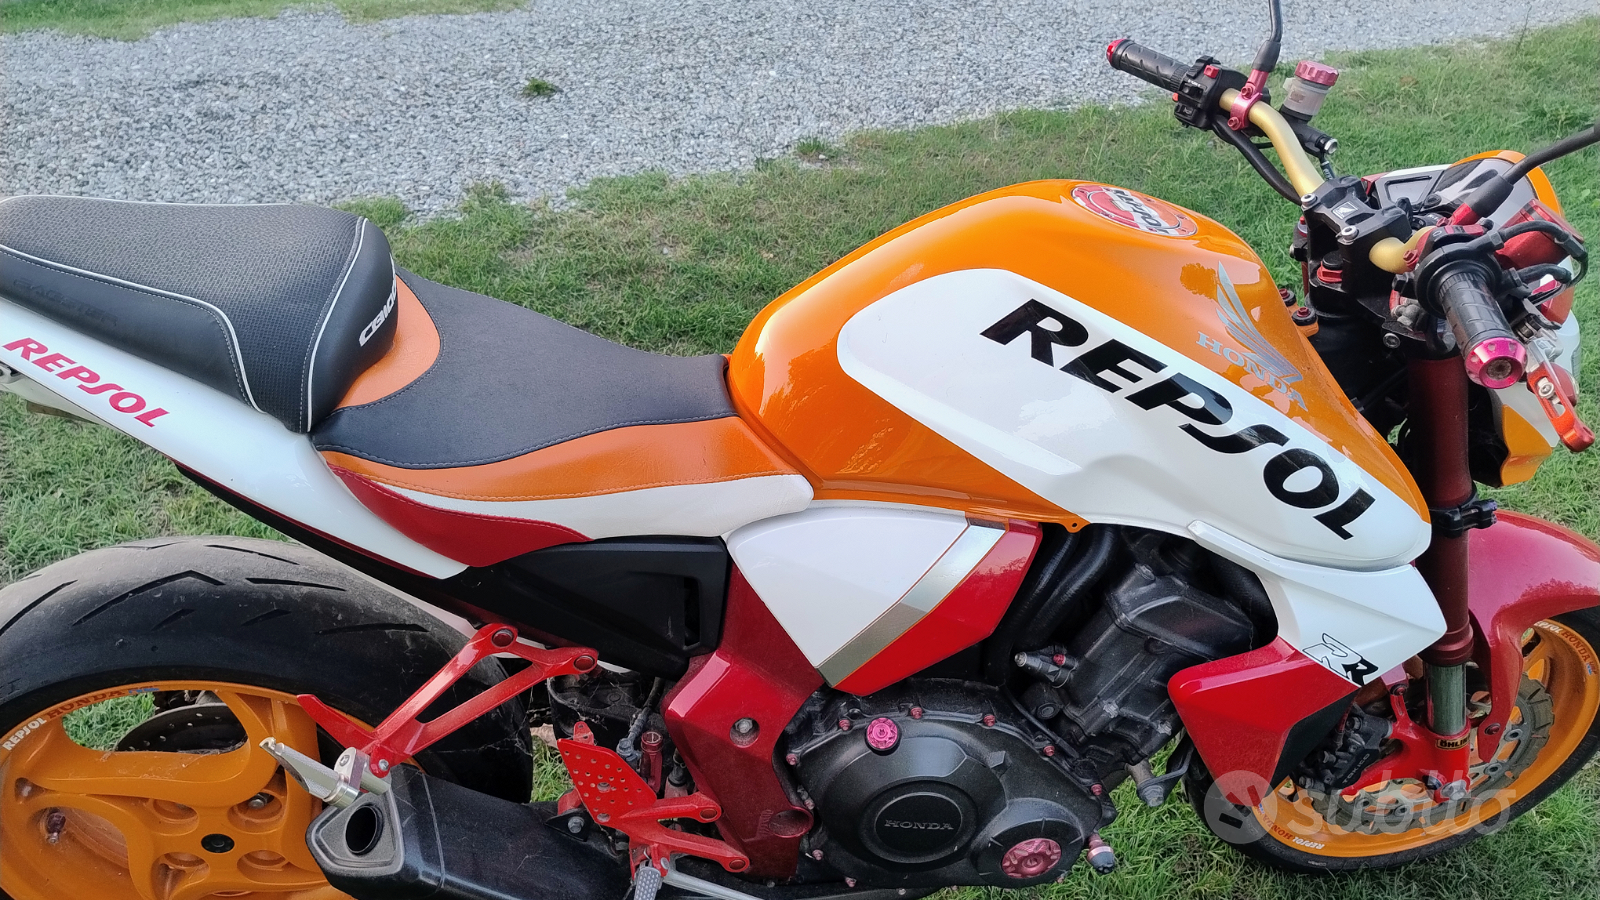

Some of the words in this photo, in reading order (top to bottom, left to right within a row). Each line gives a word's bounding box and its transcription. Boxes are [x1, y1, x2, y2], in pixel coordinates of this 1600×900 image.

[2, 337, 170, 428] REPSOL
[1196, 331, 1308, 412] HONDA
[979, 298, 1376, 541] REPSOL
[1561, 630, 1591, 662] HONDA
[2, 717, 47, 751] REPSOL
[47, 690, 127, 719] HONDA
[884, 819, 954, 830] HONDA
[1292, 836, 1325, 850] REPSOL
